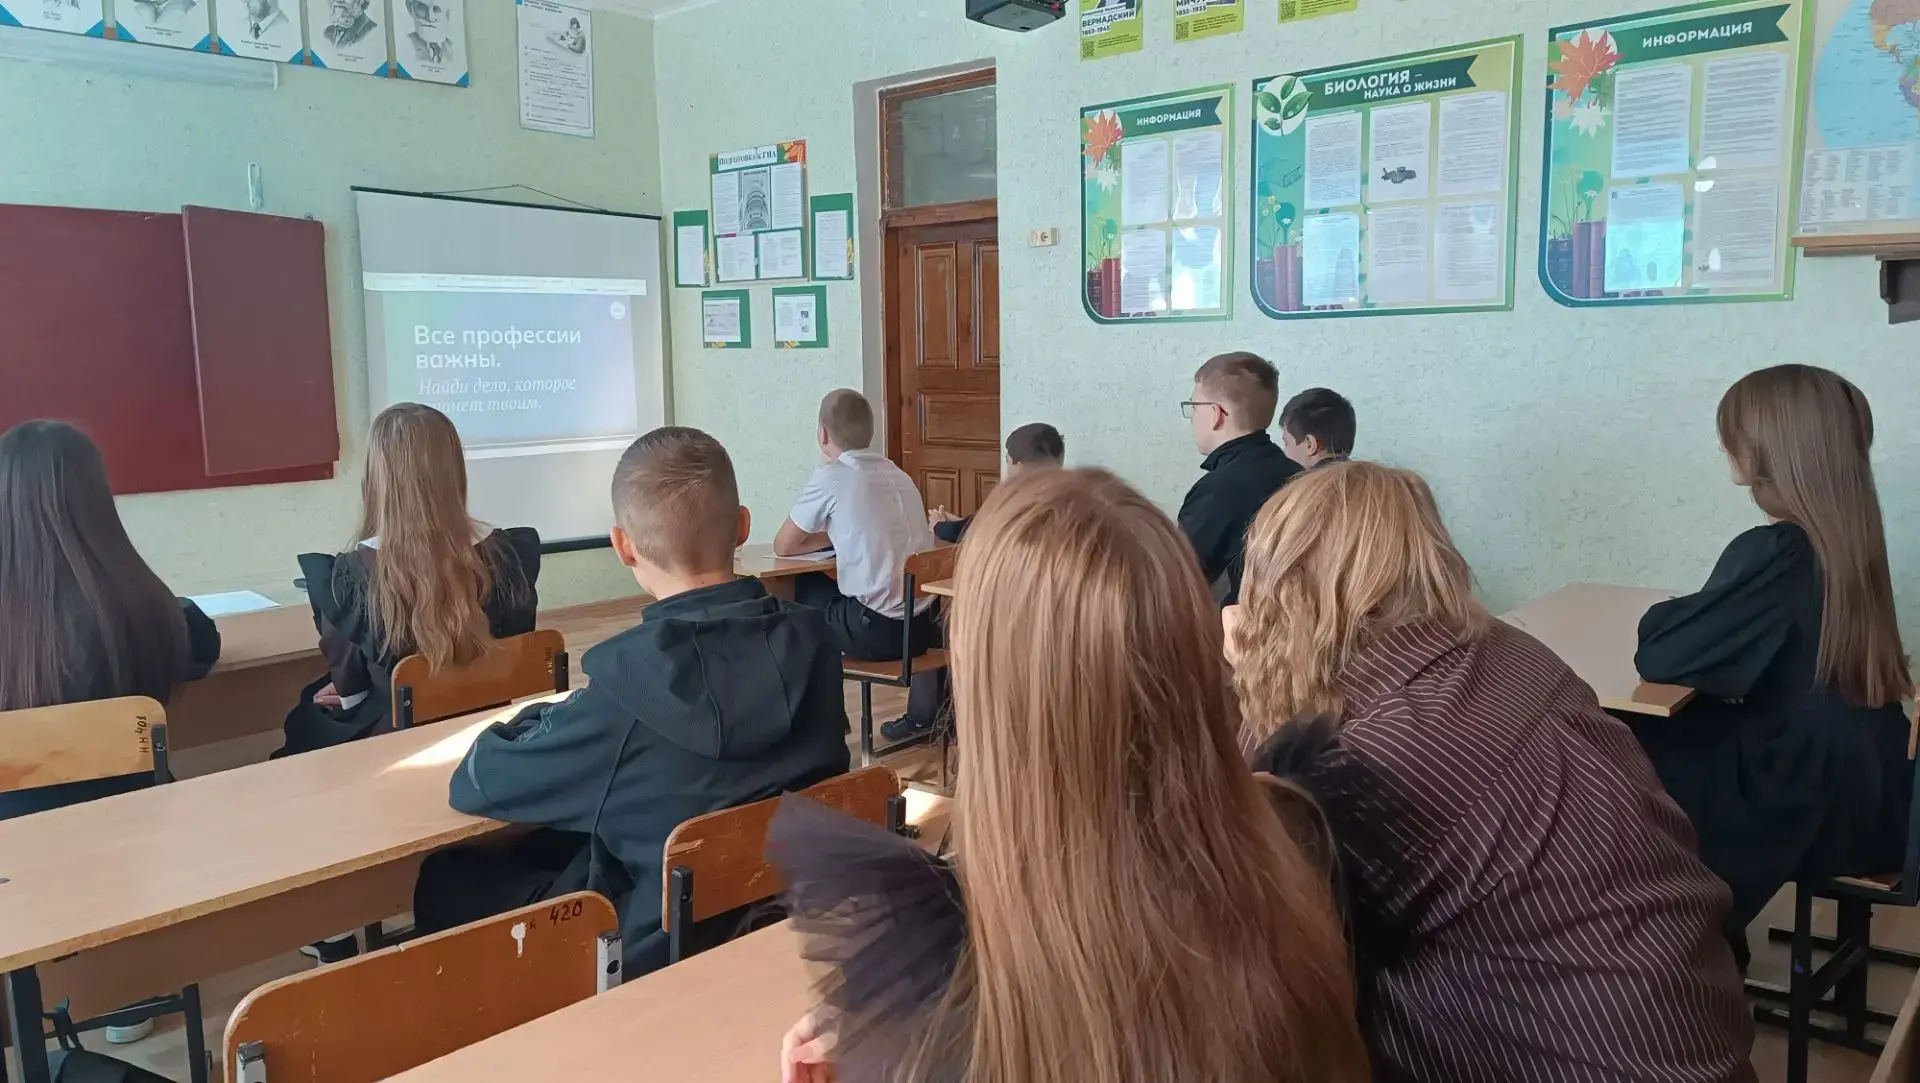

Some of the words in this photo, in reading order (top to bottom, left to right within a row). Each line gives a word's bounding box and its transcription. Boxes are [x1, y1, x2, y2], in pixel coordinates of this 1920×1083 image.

[1642, 21, 1753, 48] ИНФОРМАЦИЯ
[1324, 69, 1410, 95] БИОЛОГИЯ
[1363, 86, 1400, 99] НАУКА
[1403, 84, 1411, 93] О
[1414, 77, 1457, 92] ЖИЗНИ
[1136, 108, 1202, 126] ИНФОРМАЦИЯ
[413, 325, 455, 345] Все
[462, 325, 582, 350] профессии
[416, 353, 501, 369] важны.
[419, 377, 468, 396] Найди
[473, 376, 511, 394] дело,
[515, 378, 577, 393] которое
[487, 398, 542, 412] твоим.
[549, 899, 583, 925] 420
